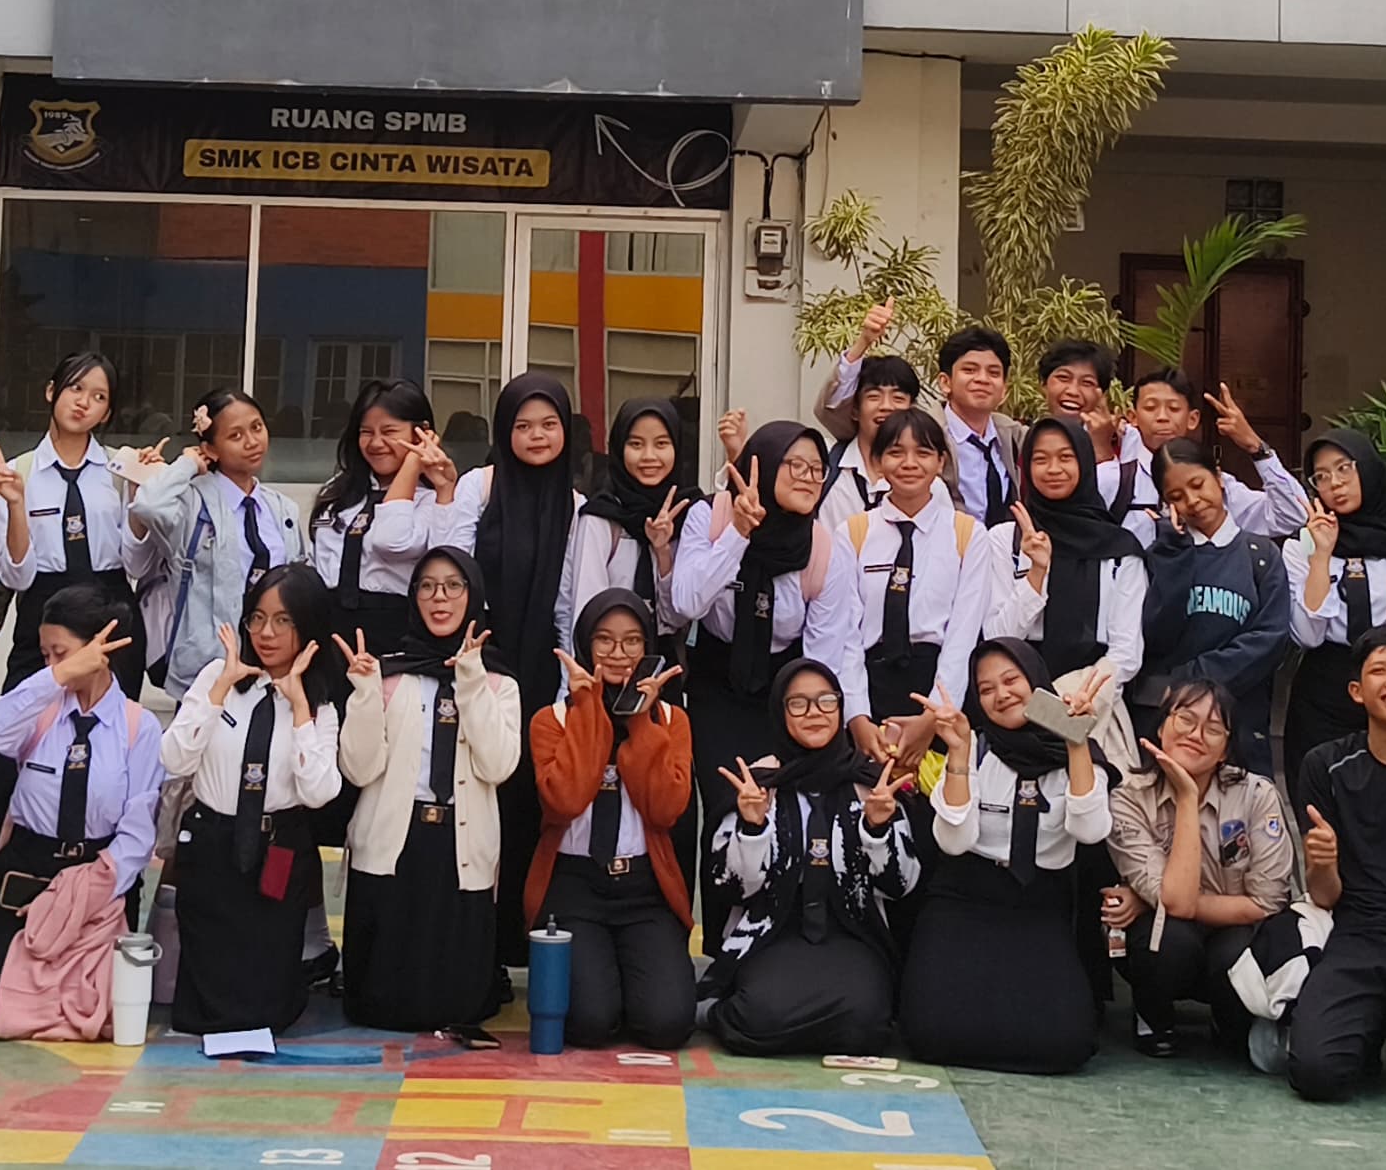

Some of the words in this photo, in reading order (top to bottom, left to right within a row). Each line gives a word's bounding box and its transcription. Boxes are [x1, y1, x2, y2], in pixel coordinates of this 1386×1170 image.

[271, 108, 375, 130] RUANG
[384, 112, 467, 133] SPMB
[199, 148, 261, 169] SMK
[272, 150, 320, 171] ICB
[330, 152, 416, 173] CINTA
[426, 154, 534, 177] WISATA
[840, 1073, 940, 1089] 3
[739, 1107, 915, 1137] 2
[259, 1148, 345, 1165] 13
